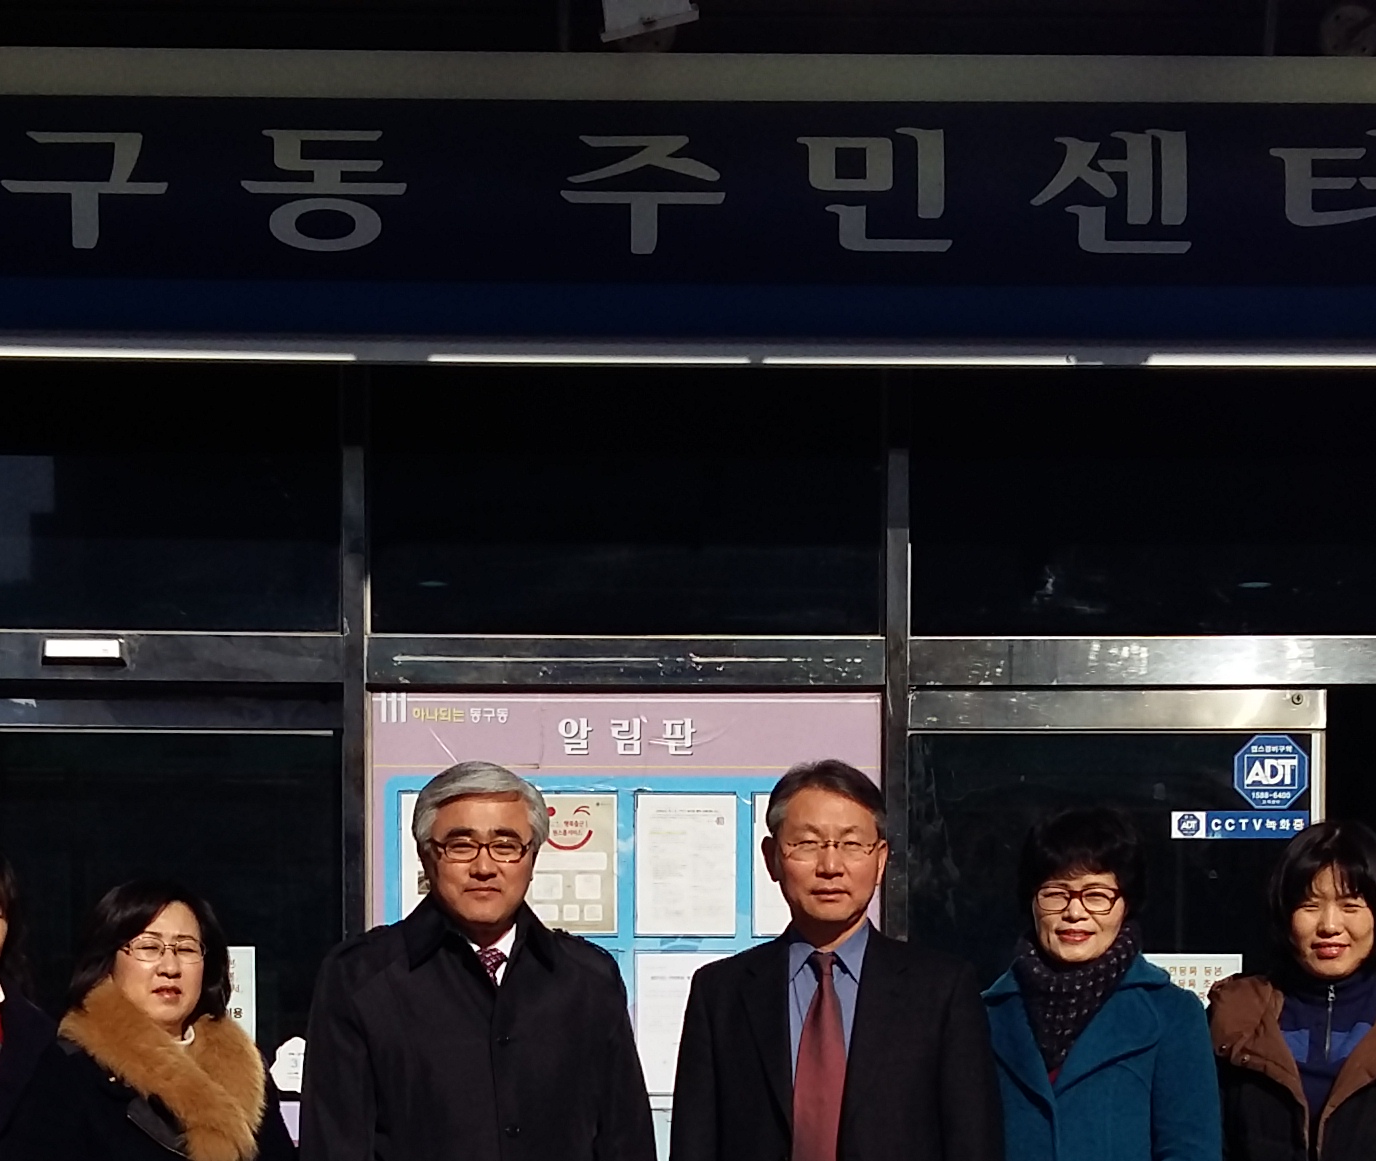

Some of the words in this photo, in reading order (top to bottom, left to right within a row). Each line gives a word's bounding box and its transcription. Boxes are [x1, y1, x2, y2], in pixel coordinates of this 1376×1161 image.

[412, 707, 465, 723] 하나되는
[470, 707, 509, 723] 동구동
[557, 716, 697, 756] 알림판
[1245, 759, 1297, 784] ADT
